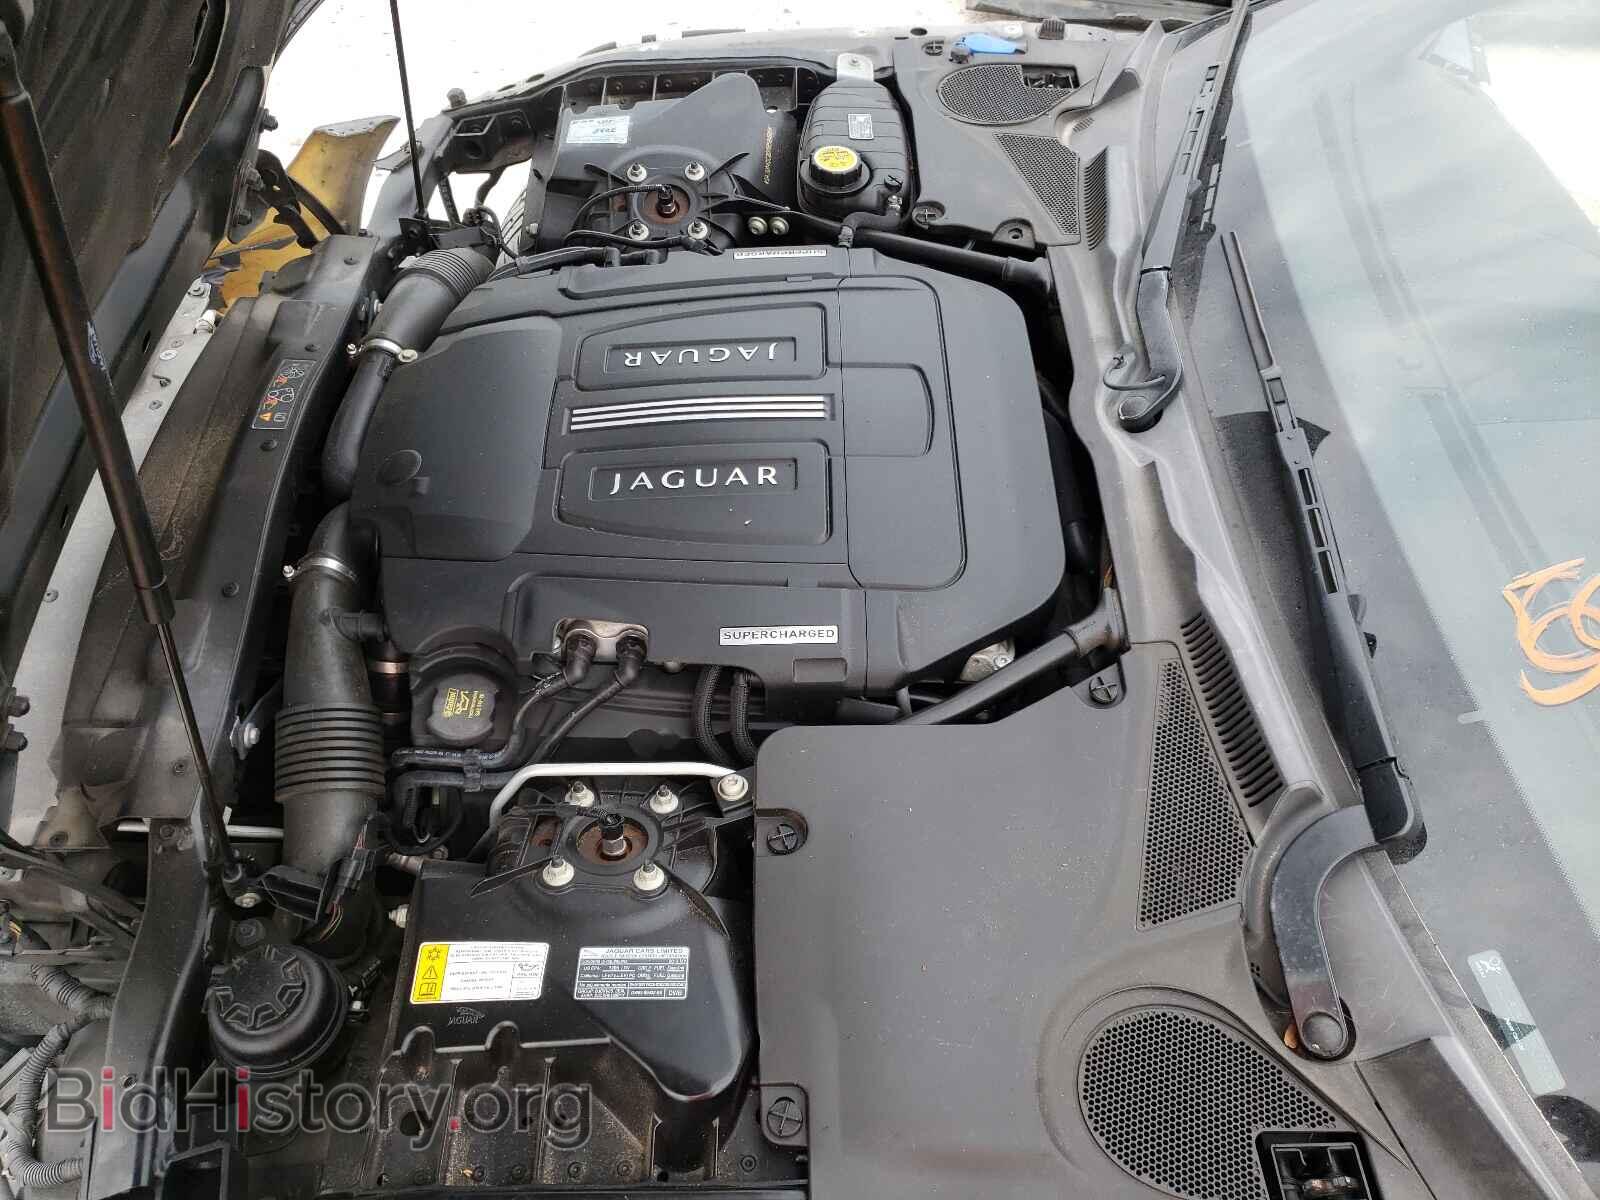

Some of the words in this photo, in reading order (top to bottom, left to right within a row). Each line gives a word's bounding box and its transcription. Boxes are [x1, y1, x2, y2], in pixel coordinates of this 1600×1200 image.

[624, 342, 778, 367] JAGUAR
[609, 466, 778, 495] JAGUAR
[723, 629, 835, 640] SUPERCHARGED
[448, 1016, 480, 1026] JAGUAR
